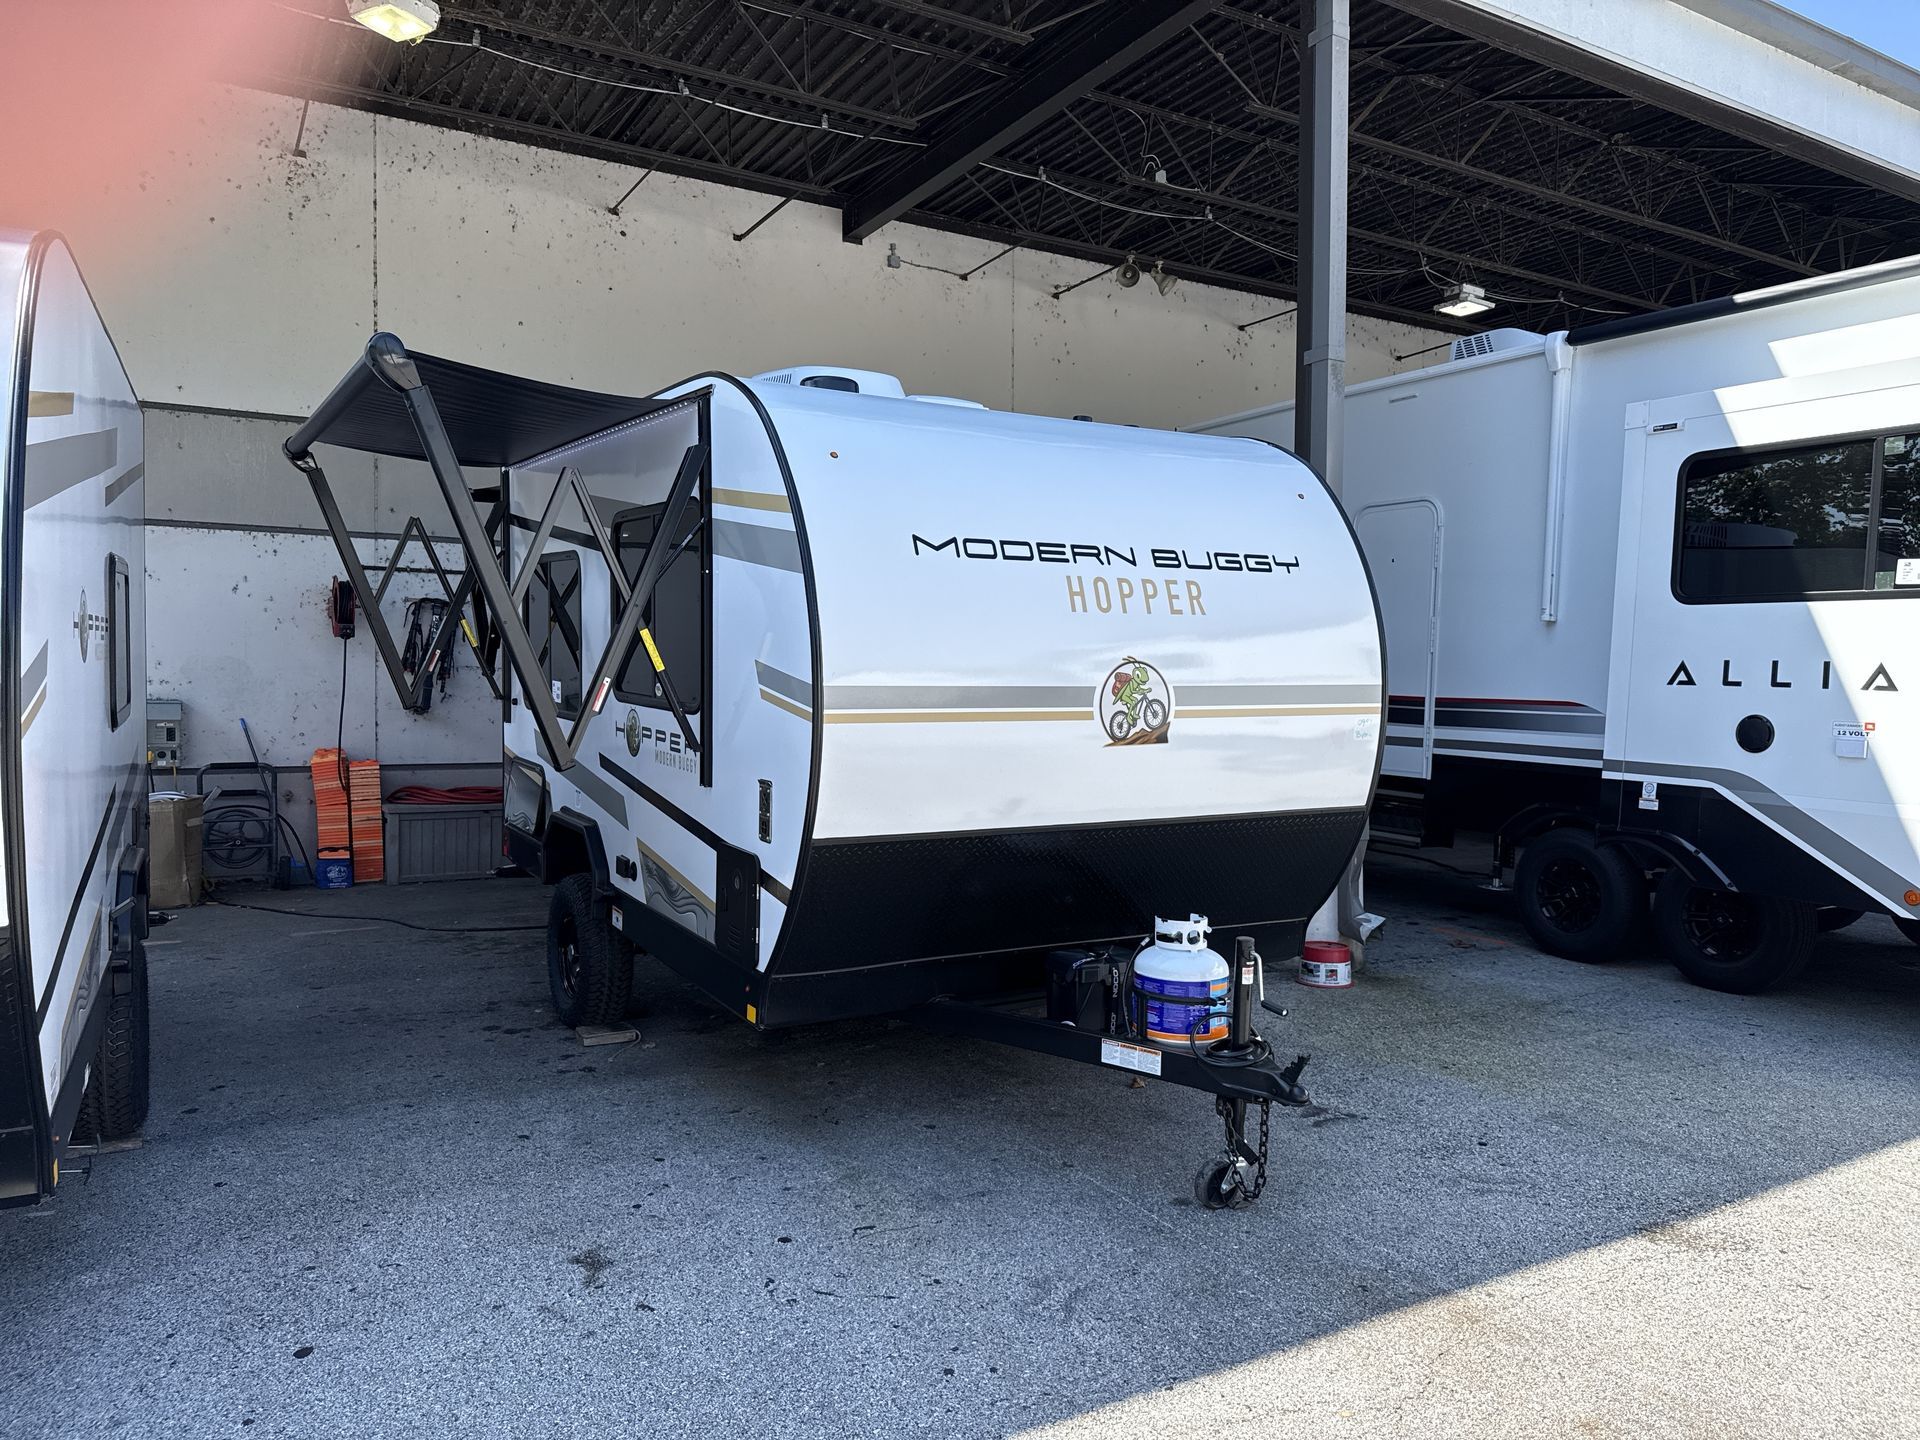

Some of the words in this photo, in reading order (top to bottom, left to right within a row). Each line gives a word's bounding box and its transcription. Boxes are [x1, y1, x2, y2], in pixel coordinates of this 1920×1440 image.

[911, 533, 1137, 568] MODERN
[1150, 548, 1300, 574] BUGGY
[1065, 574, 1207, 616] HOPPER
[1666, 659, 1899, 692] ALLIA
[654, 749, 677, 768] MODERN
[678, 755, 698, 775] BUGGY
